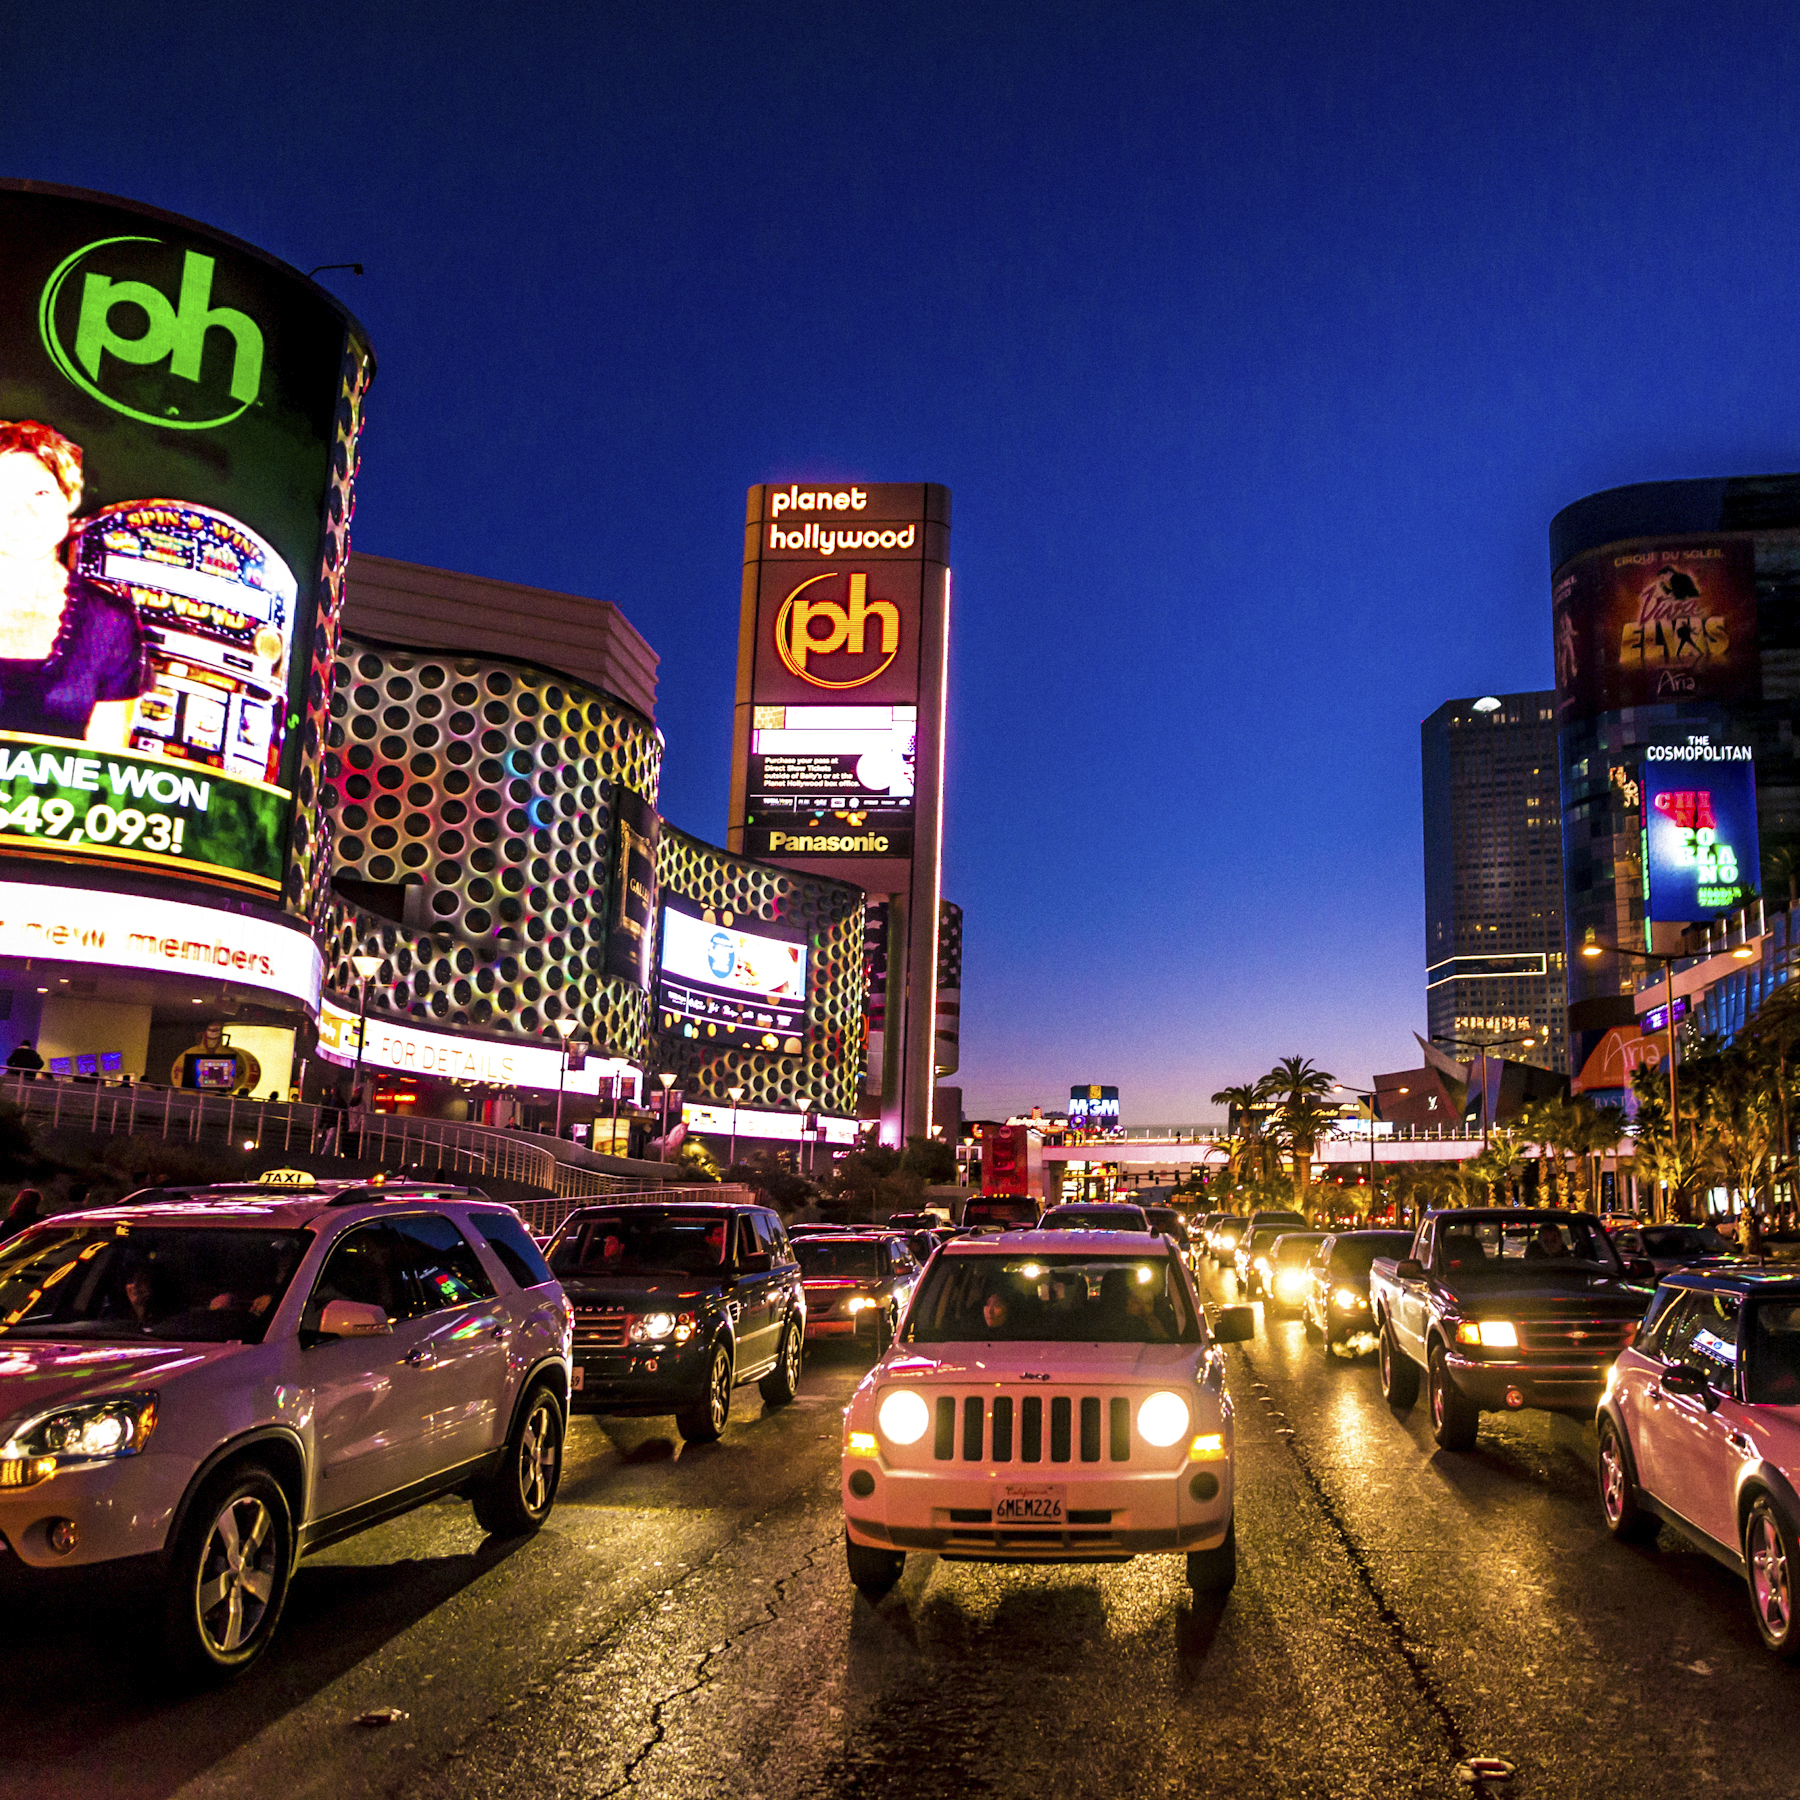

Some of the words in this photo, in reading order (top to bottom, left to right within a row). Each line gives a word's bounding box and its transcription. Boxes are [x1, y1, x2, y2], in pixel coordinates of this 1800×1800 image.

[75, 250, 264, 404] ph
[771, 485, 867, 518] planet
[126, 511, 181, 527] SPIN
[769, 523, 916, 555] hollywood
[1662, 550, 1681, 561] DU
[789, 572, 900, 670] ph
[1656, 670, 1696, 694] Aria
[1688, 736, 1710, 746] THE
[1646, 746, 1752, 761] COSMOPOLITAN
[0, 748, 101, 792] ANE
[108, 762, 210, 811] WON
[787, 780, 824, 788] Hollywood
[769, 832, 889, 852] Panasonic
[23, 922, 107, 948] new
[127, 933, 276, 976] members.
[381, 1037, 416, 1069] FOR
[422, 1046, 515, 1081] DETAILS
[1603, 1032, 1661, 1073] Aria
[1068, 1098, 1120, 1117] MGM
[265, 1173, 302, 1182] TAXI
[1019, 1371, 1050, 1381] Jeep
[996, 1498, 1062, 1517] 6MEM226
